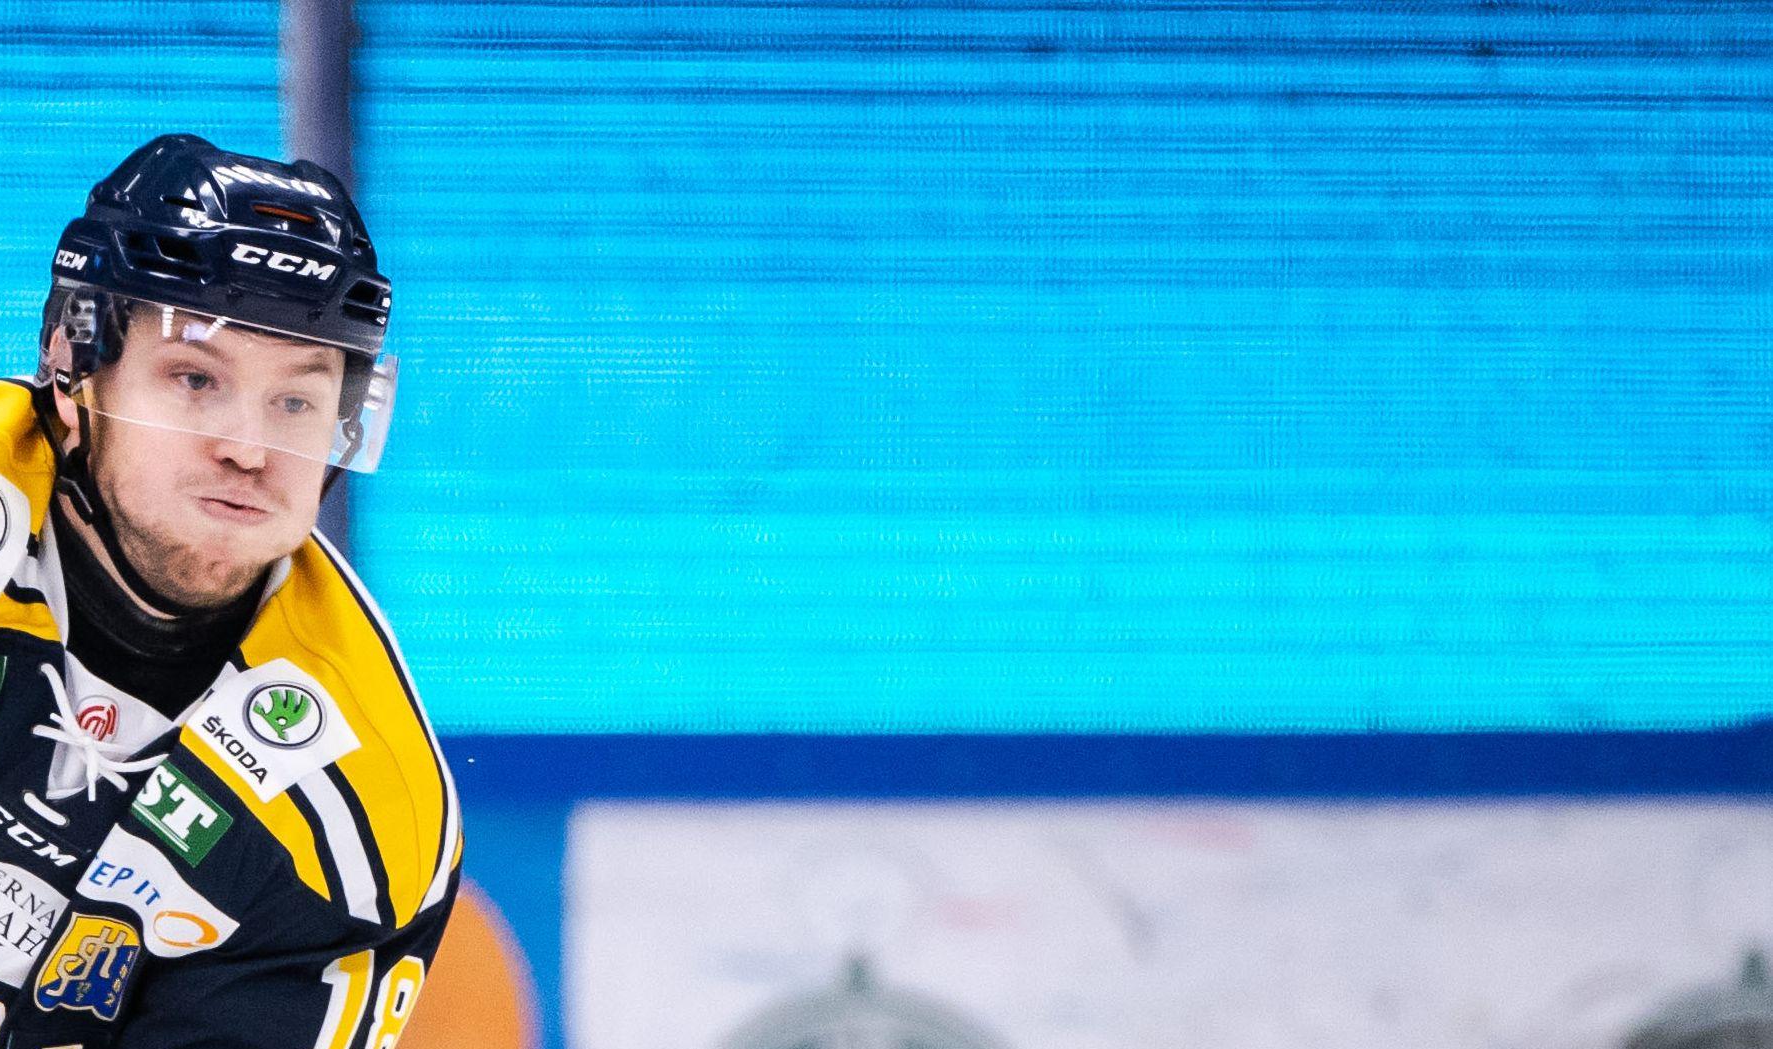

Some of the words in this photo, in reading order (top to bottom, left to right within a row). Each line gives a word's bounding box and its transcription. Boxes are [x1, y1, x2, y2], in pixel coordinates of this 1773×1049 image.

[56, 249, 87, 270] CCM
[231, 243, 336, 280] CCM
[201, 716, 270, 786] ŠKODA
[136, 765, 218, 839] ST
[132, 879, 161, 906] IT
